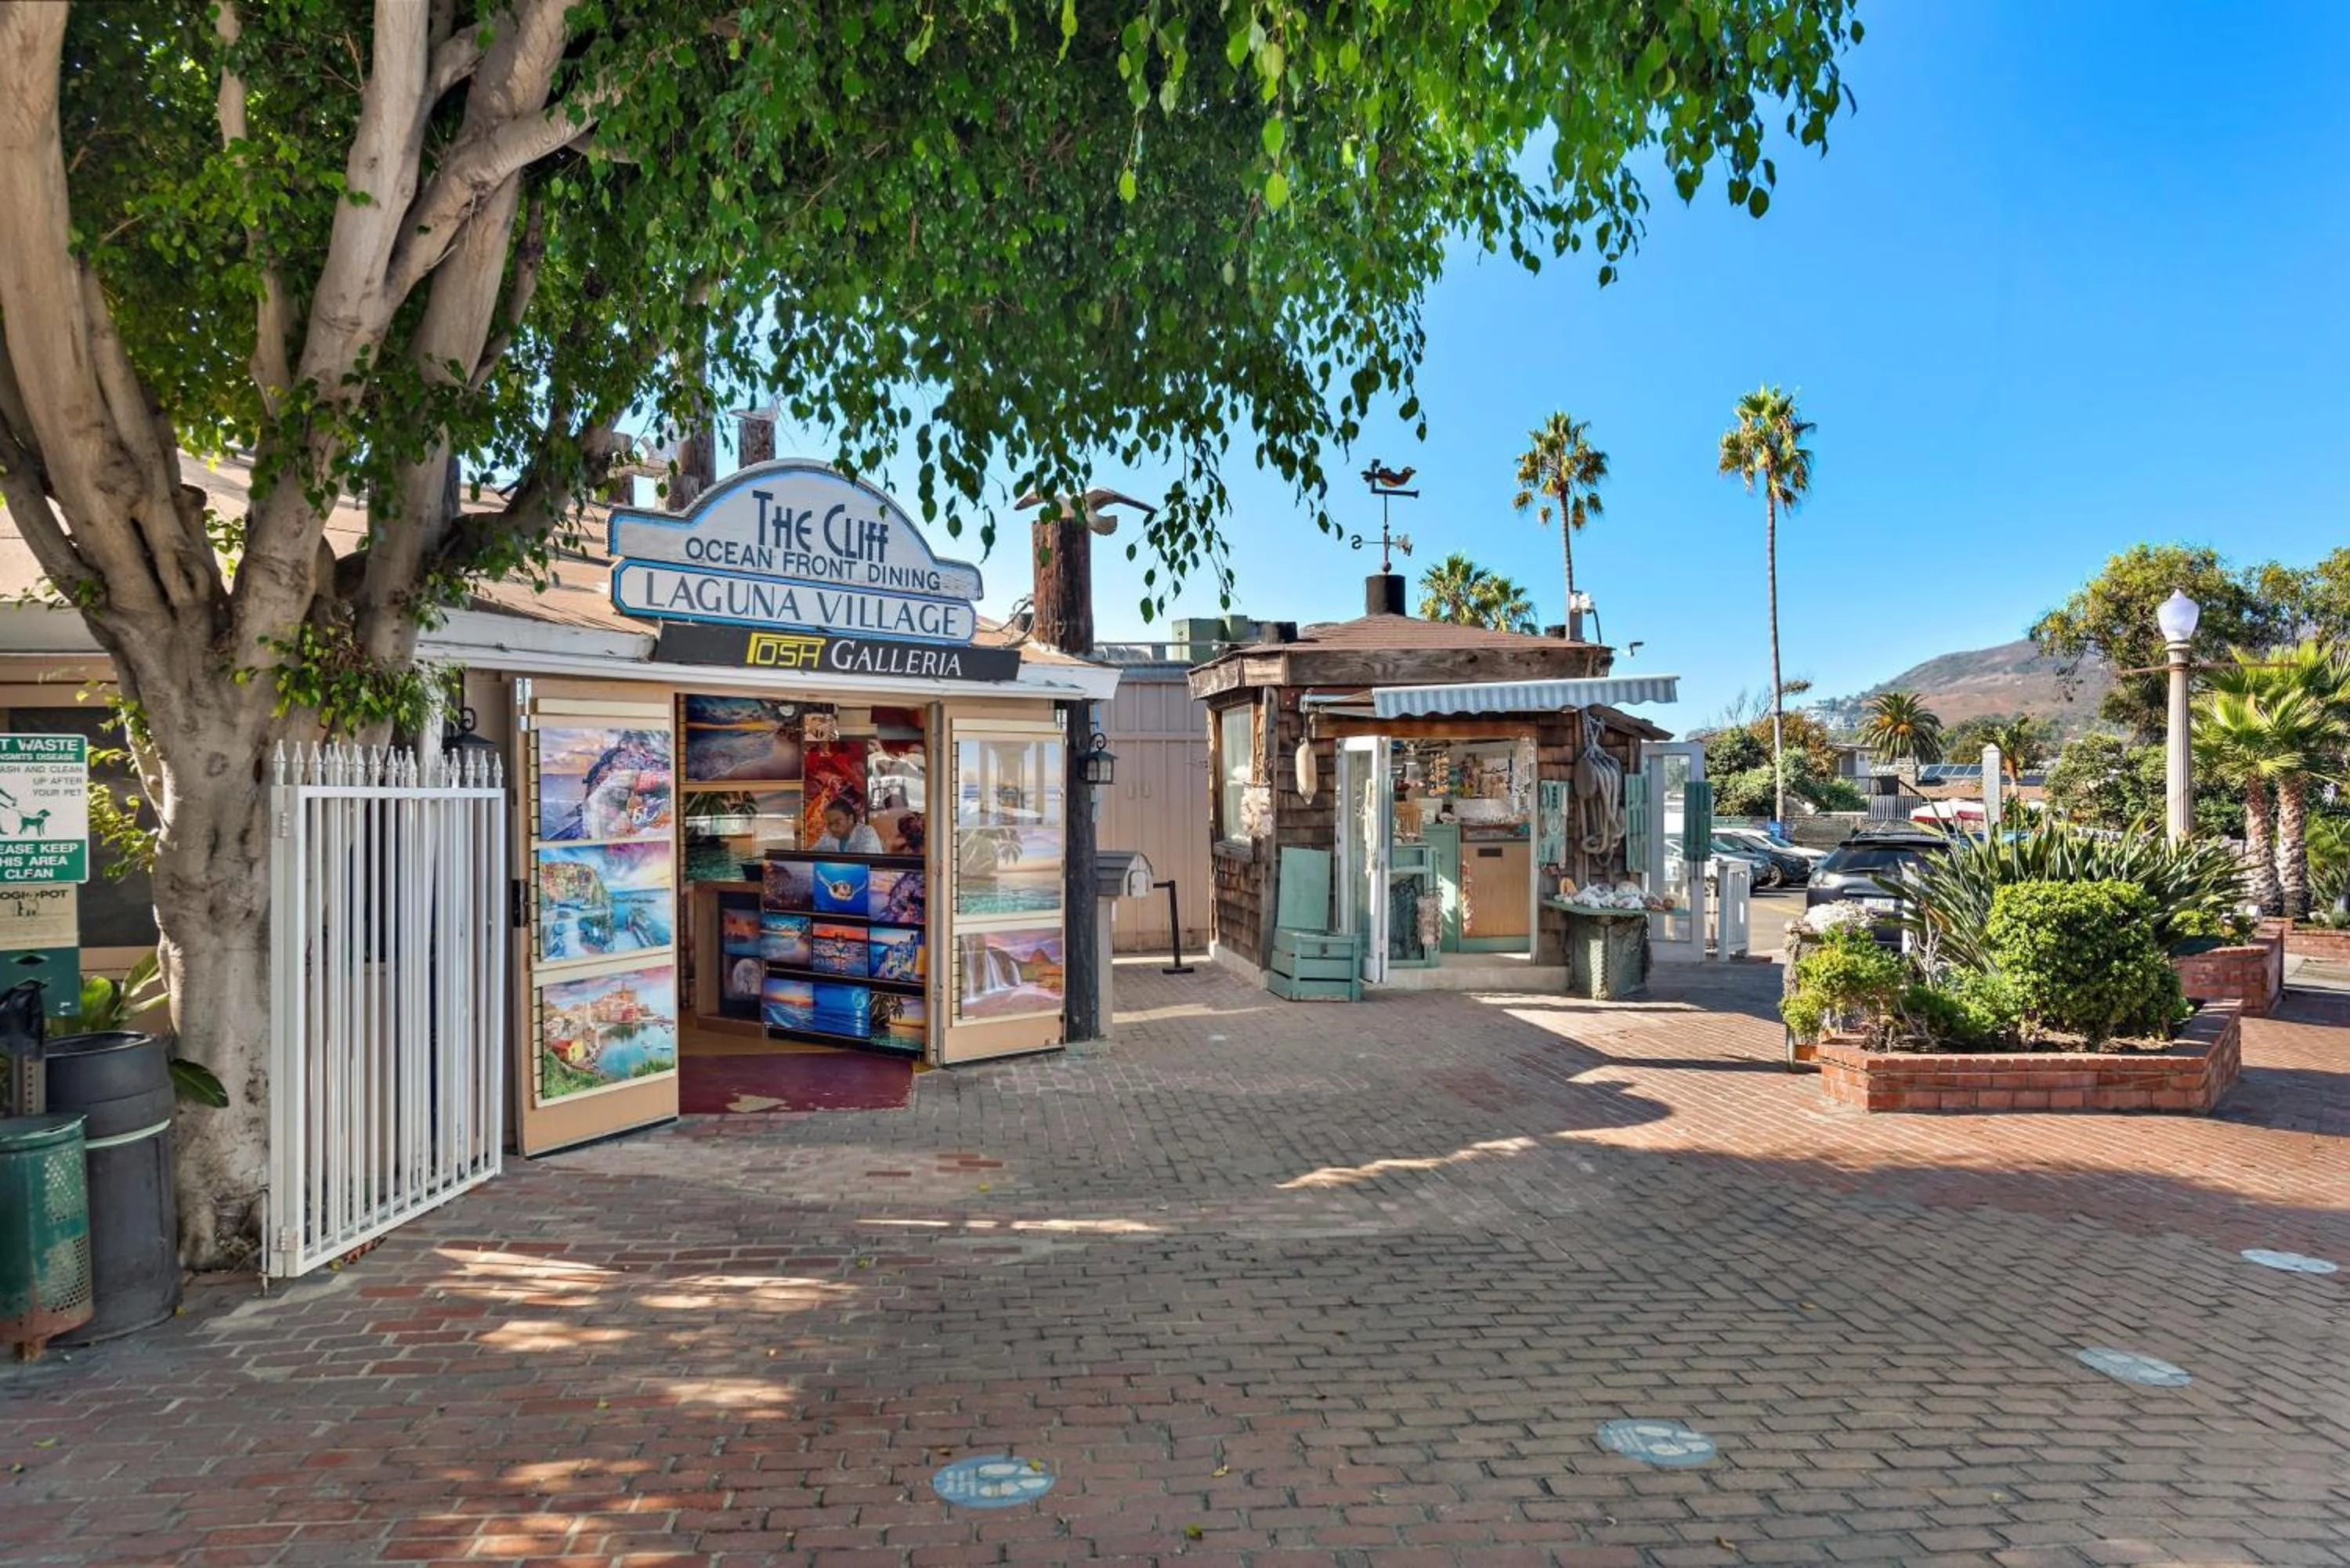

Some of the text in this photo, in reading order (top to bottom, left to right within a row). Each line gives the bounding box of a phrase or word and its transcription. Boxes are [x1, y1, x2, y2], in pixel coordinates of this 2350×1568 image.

[752, 490, 889, 562] THE CLIFF
[685, 537, 941, 591] OCEAN FRONT DINING
[645, 571, 959, 636] LAGUNA VILLAGE
[745, 631, 963, 677] TOSH GALLERIA
[16, 739, 79, 751] WASTE
[25, 765, 46, 774] AND
[40, 843, 78, 854] KEEP
[29, 855, 69, 866] AREA
[5, 868, 54, 879] CLEAN
